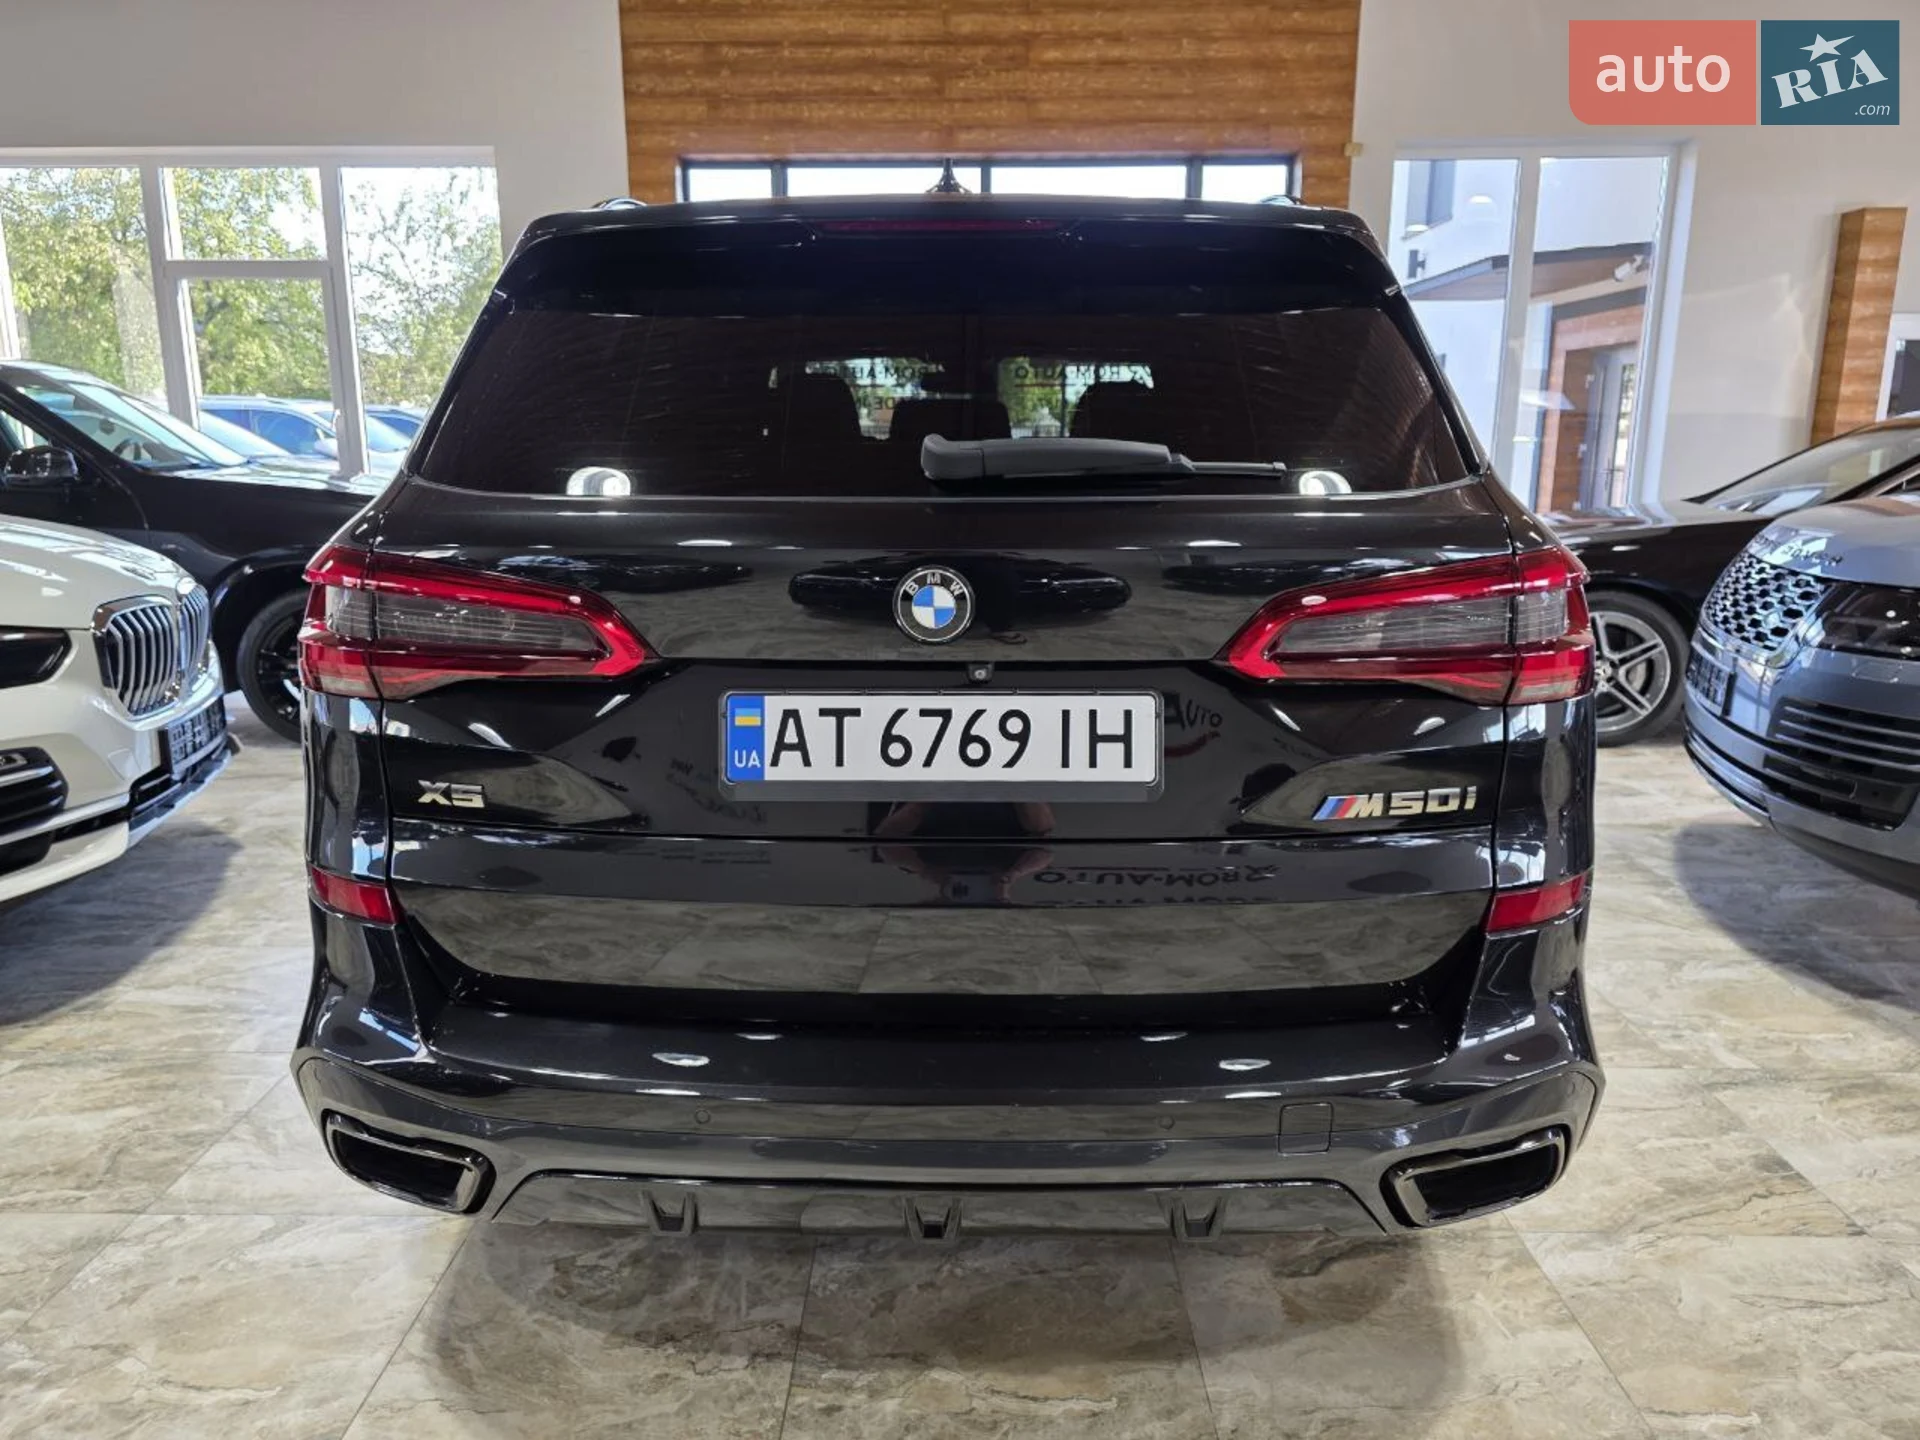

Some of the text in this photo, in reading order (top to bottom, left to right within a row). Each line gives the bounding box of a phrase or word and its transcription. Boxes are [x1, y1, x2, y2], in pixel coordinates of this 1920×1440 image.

[905, 571, 964, 597] BMW
[769, 708, 1134, 769] AT 6769 IH
[733, 749, 761, 768] UA
[417, 780, 486, 808] X5
